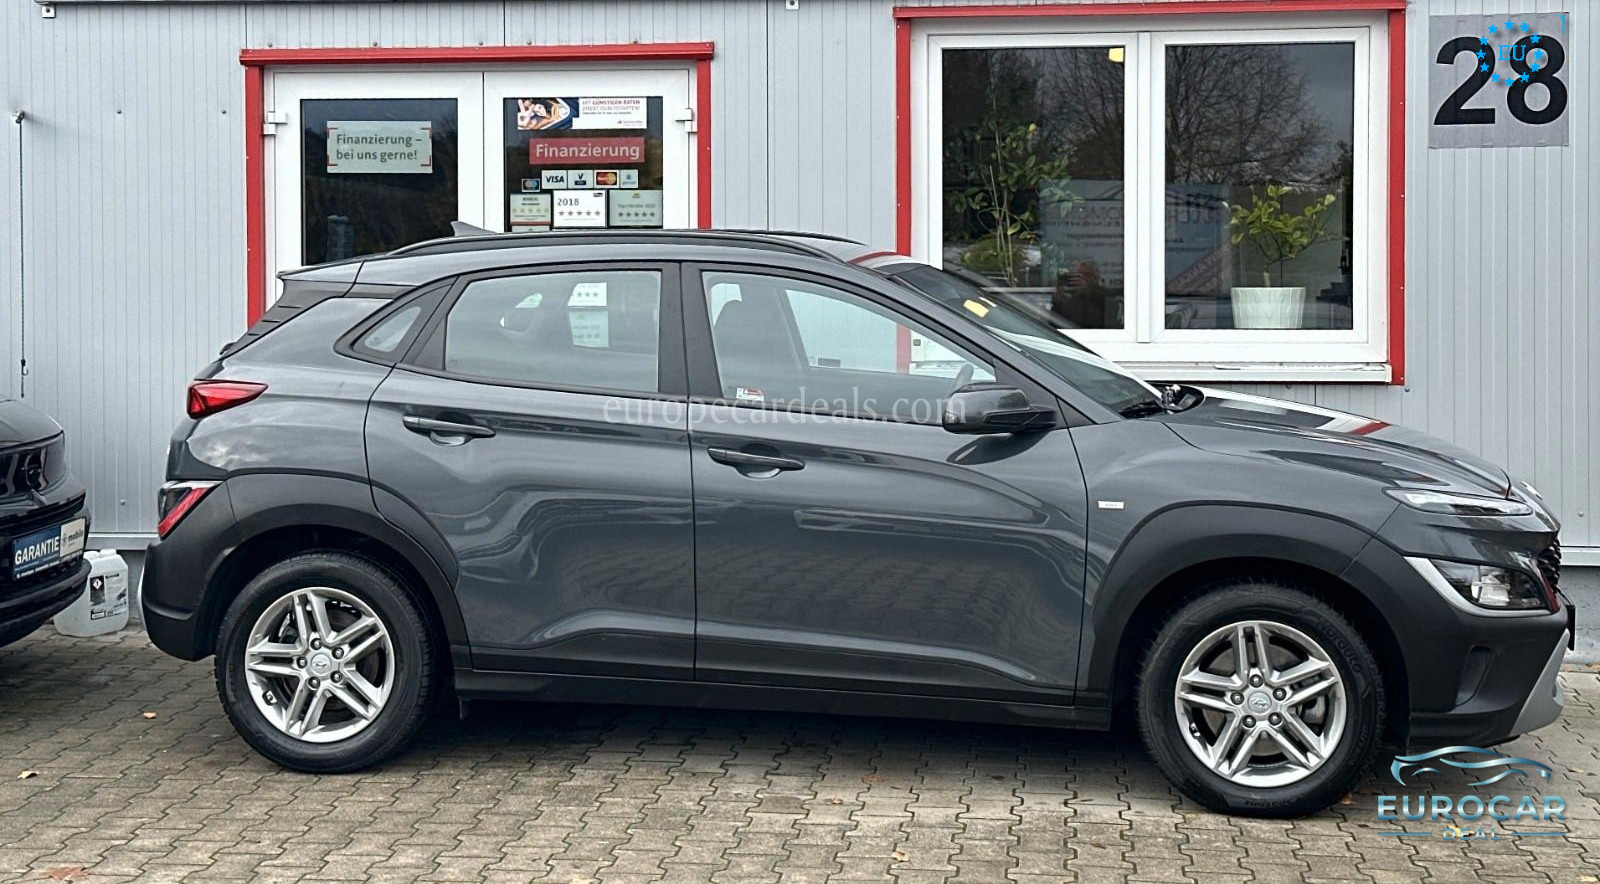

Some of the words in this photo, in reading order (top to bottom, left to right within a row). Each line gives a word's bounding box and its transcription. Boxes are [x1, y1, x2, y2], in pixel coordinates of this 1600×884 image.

[1433, 34, 1568, 125] 28
[336, 133, 412, 147] Finanzierung
[336, 149, 354, 160] bei
[357, 151, 378, 160] uns
[380, 150, 417, 163] gerne!
[536, 143, 640, 160] Finanzierung
[545, 175, 565, 183] VISA
[557, 198, 580, 206] 2018
[14, 536, 60, 566] GARANTIE
